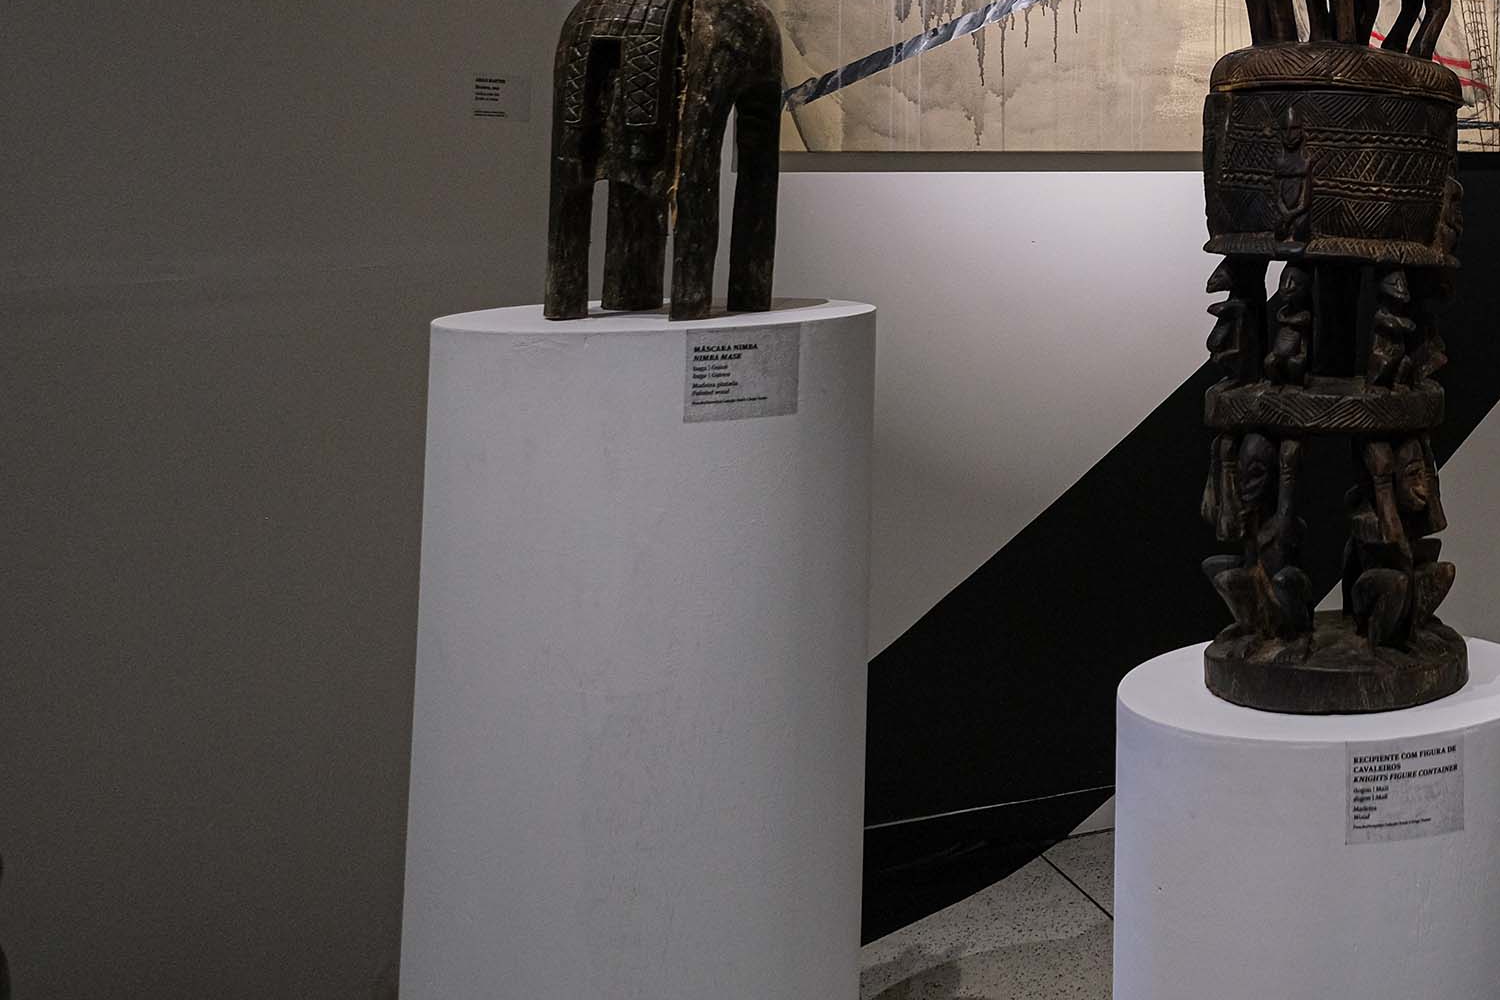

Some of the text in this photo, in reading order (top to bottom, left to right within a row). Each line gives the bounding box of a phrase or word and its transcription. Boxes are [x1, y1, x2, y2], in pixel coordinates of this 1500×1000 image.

[694, 343, 758, 353] MÁSCARA NIMBA
[1353, 745, 1456, 764] RECIPIENTE COM FIGURA DE
[1353, 763, 1401, 773] CAVALEIROS
[1353, 764, 1458, 783] KNIGHTS FIGURE CONTAINER
